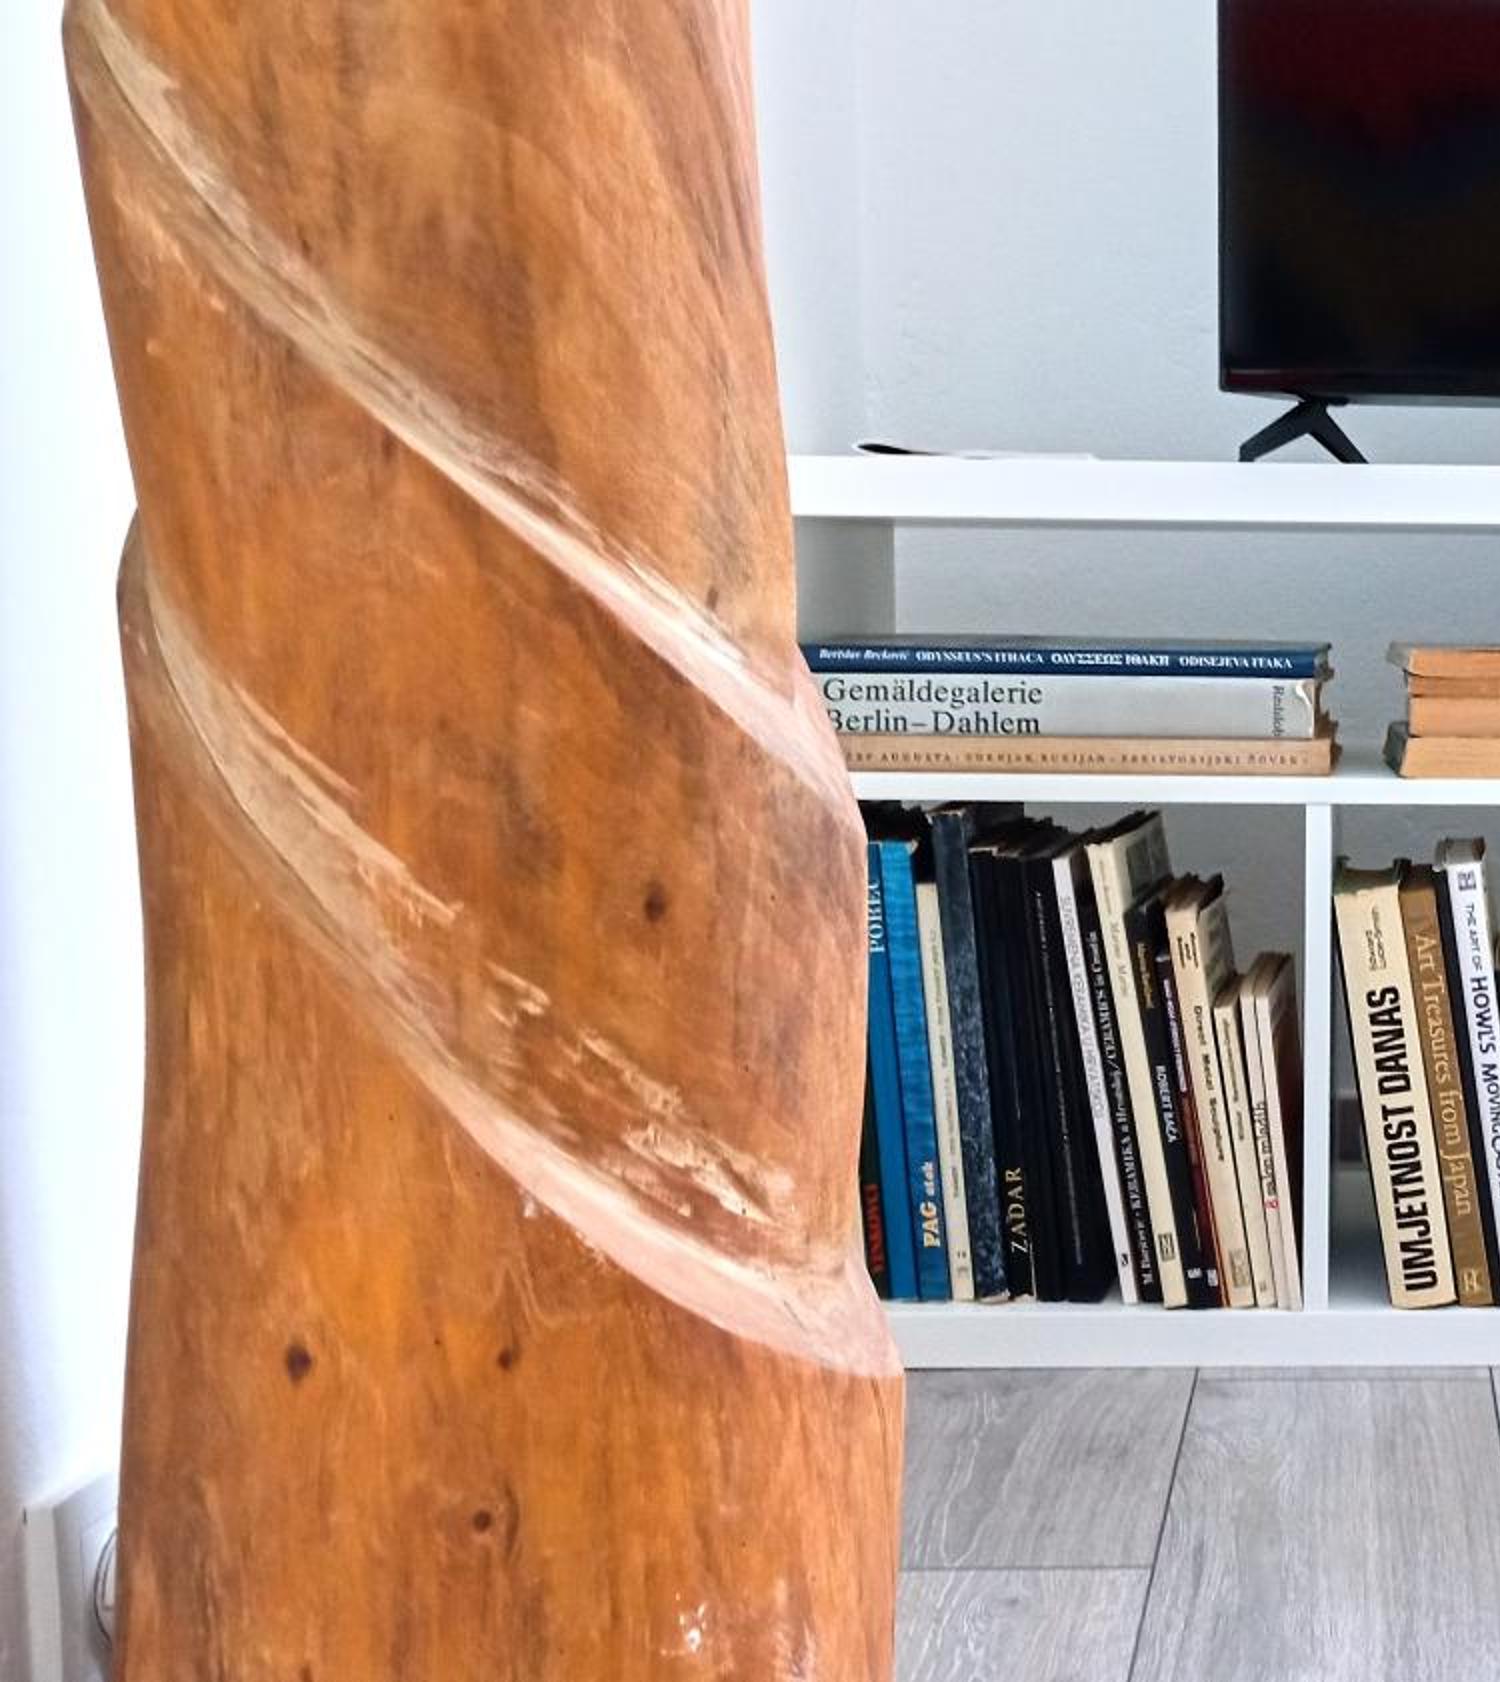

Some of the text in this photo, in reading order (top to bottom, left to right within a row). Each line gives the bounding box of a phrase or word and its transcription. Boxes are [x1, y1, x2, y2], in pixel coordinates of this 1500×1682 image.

[994, 652, 1044, 663] ITHACA
[1179, 656, 1293, 669] ODISEJEVA ITAKA
[823, 678, 1043, 709] Gemäldegalerie
[1464, 903, 1477, 927] THE
[1470, 929, 1480, 954] ART
[1472, 955, 1483, 971] OF
[1470, 976, 1496, 1054] HOWL'S
[1193, 1004, 1208, 1046] Direct
[1201, 1053, 1214, 1090] Metal
[1155, 1063, 1173, 1110] ROBERT
[1415, 932, 1471, 1215] Art Treasures from Japan
[1365, 986, 1438, 1291] UMJETNOST DANAS
[919, 1201, 940, 1248] PAG
[1005, 1167, 1029, 1254] ZADAR
